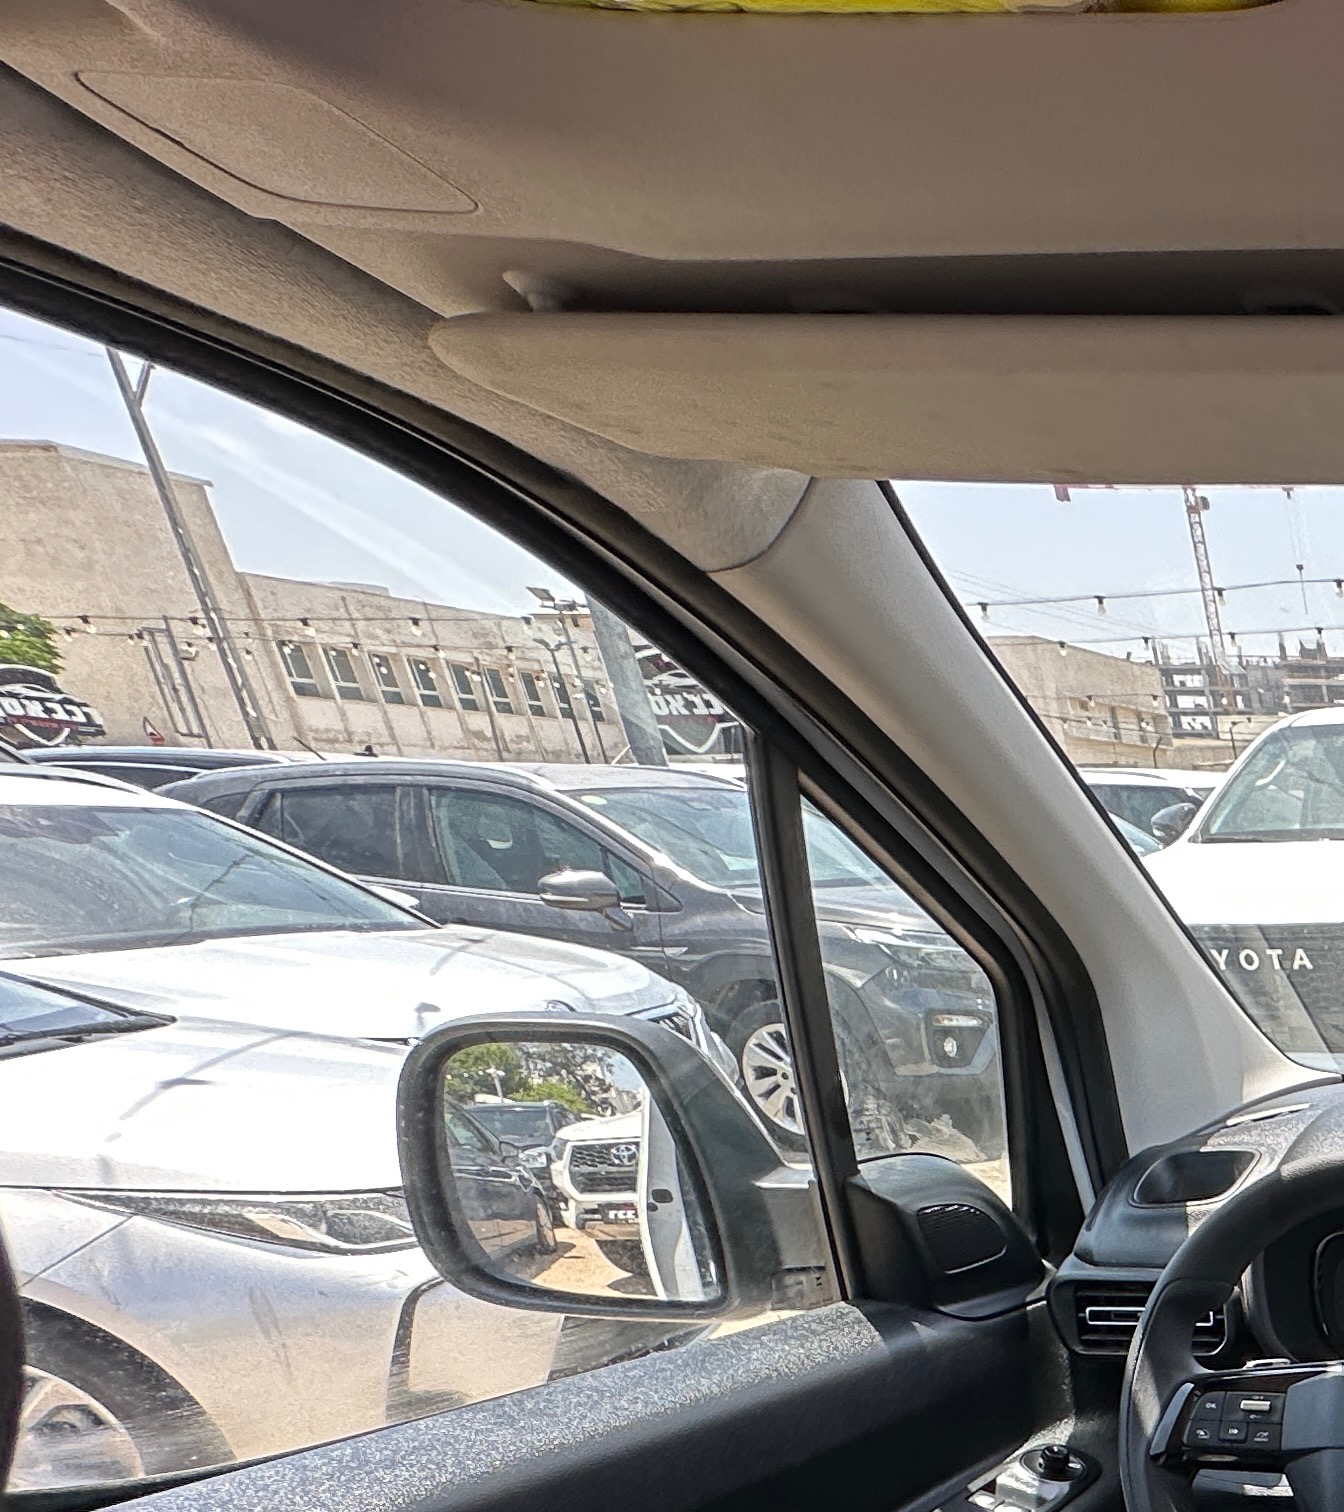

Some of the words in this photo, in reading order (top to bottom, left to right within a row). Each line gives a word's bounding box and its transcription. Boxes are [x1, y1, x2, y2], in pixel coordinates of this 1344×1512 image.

[0, 696, 50, 718] אס
[43, 701, 105, 726] רכב
[682, 692, 725, 715] כב
[1209, 948, 1314, 971] YOTA
